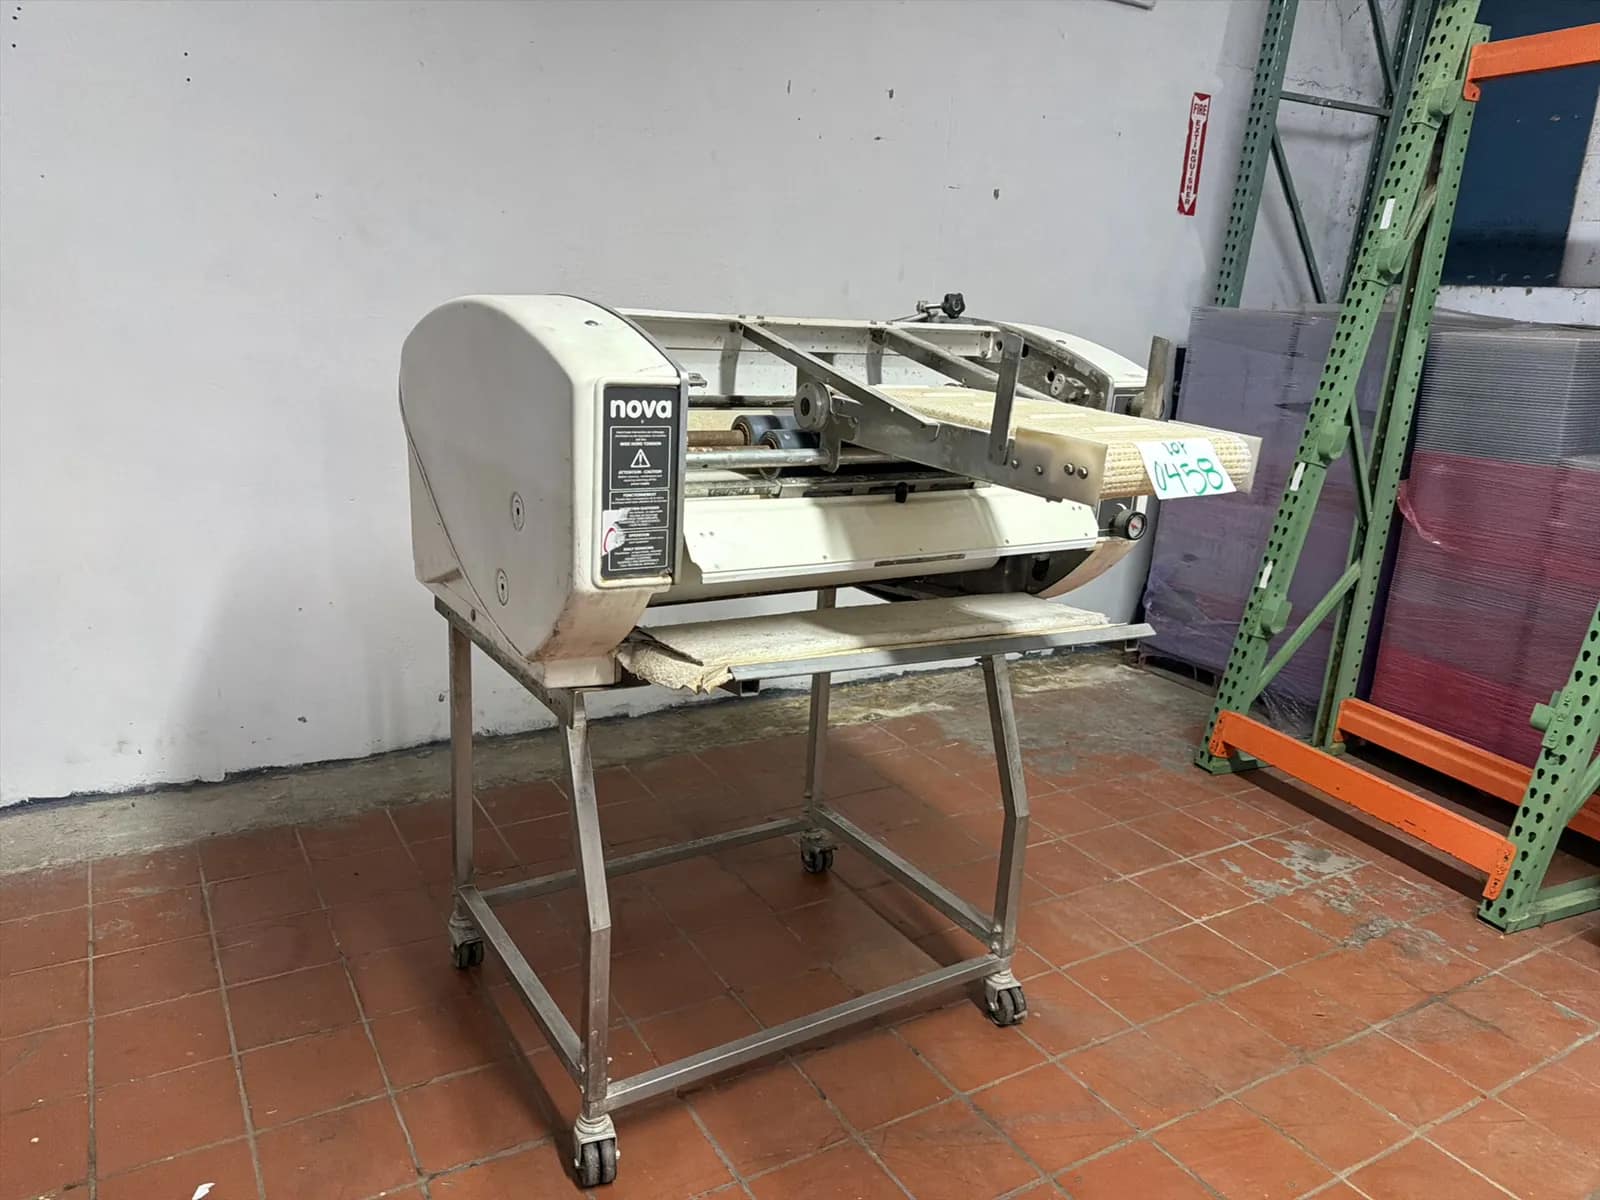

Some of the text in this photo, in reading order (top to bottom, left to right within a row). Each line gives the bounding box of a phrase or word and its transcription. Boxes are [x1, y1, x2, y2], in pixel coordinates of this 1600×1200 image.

[1193, 103, 1207, 116] FIRE
[1185, 119, 1201, 205] EXTINGUISHER
[610, 399, 672, 418] nova
[1154, 457, 1224, 496] 0458
